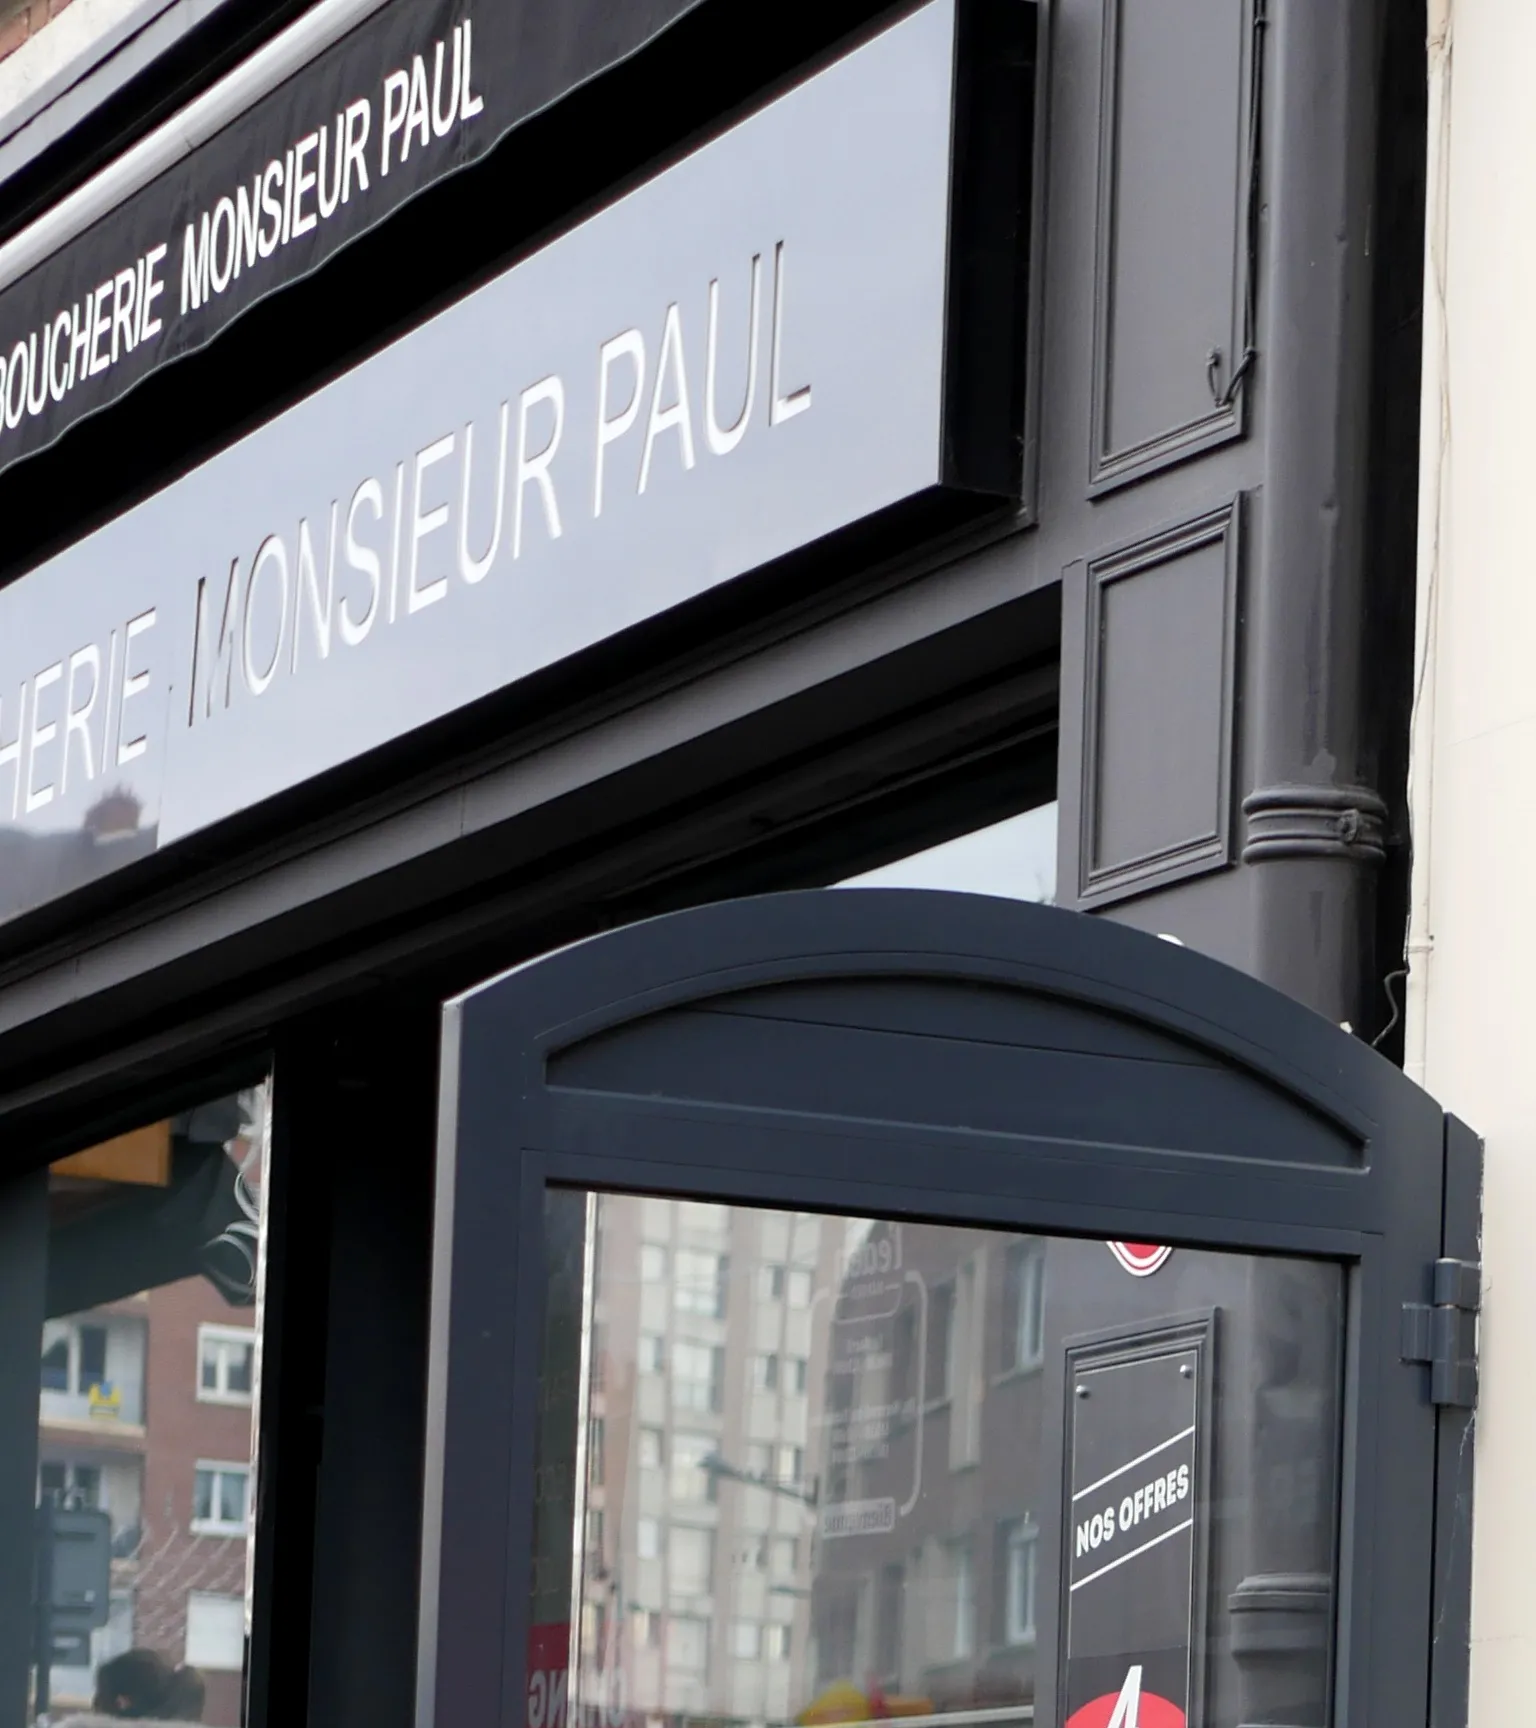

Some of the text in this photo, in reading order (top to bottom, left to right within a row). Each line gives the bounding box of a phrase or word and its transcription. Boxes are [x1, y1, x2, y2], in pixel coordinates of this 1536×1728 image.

[180, 98, 371, 315] MONSIEUR
[381, 19, 484, 177] PAUL
[188, 373, 564, 729] MONSIEUR
[592, 240, 812, 518] PAUL
[1076, 1464, 1189, 1558] NOS OFFRES
